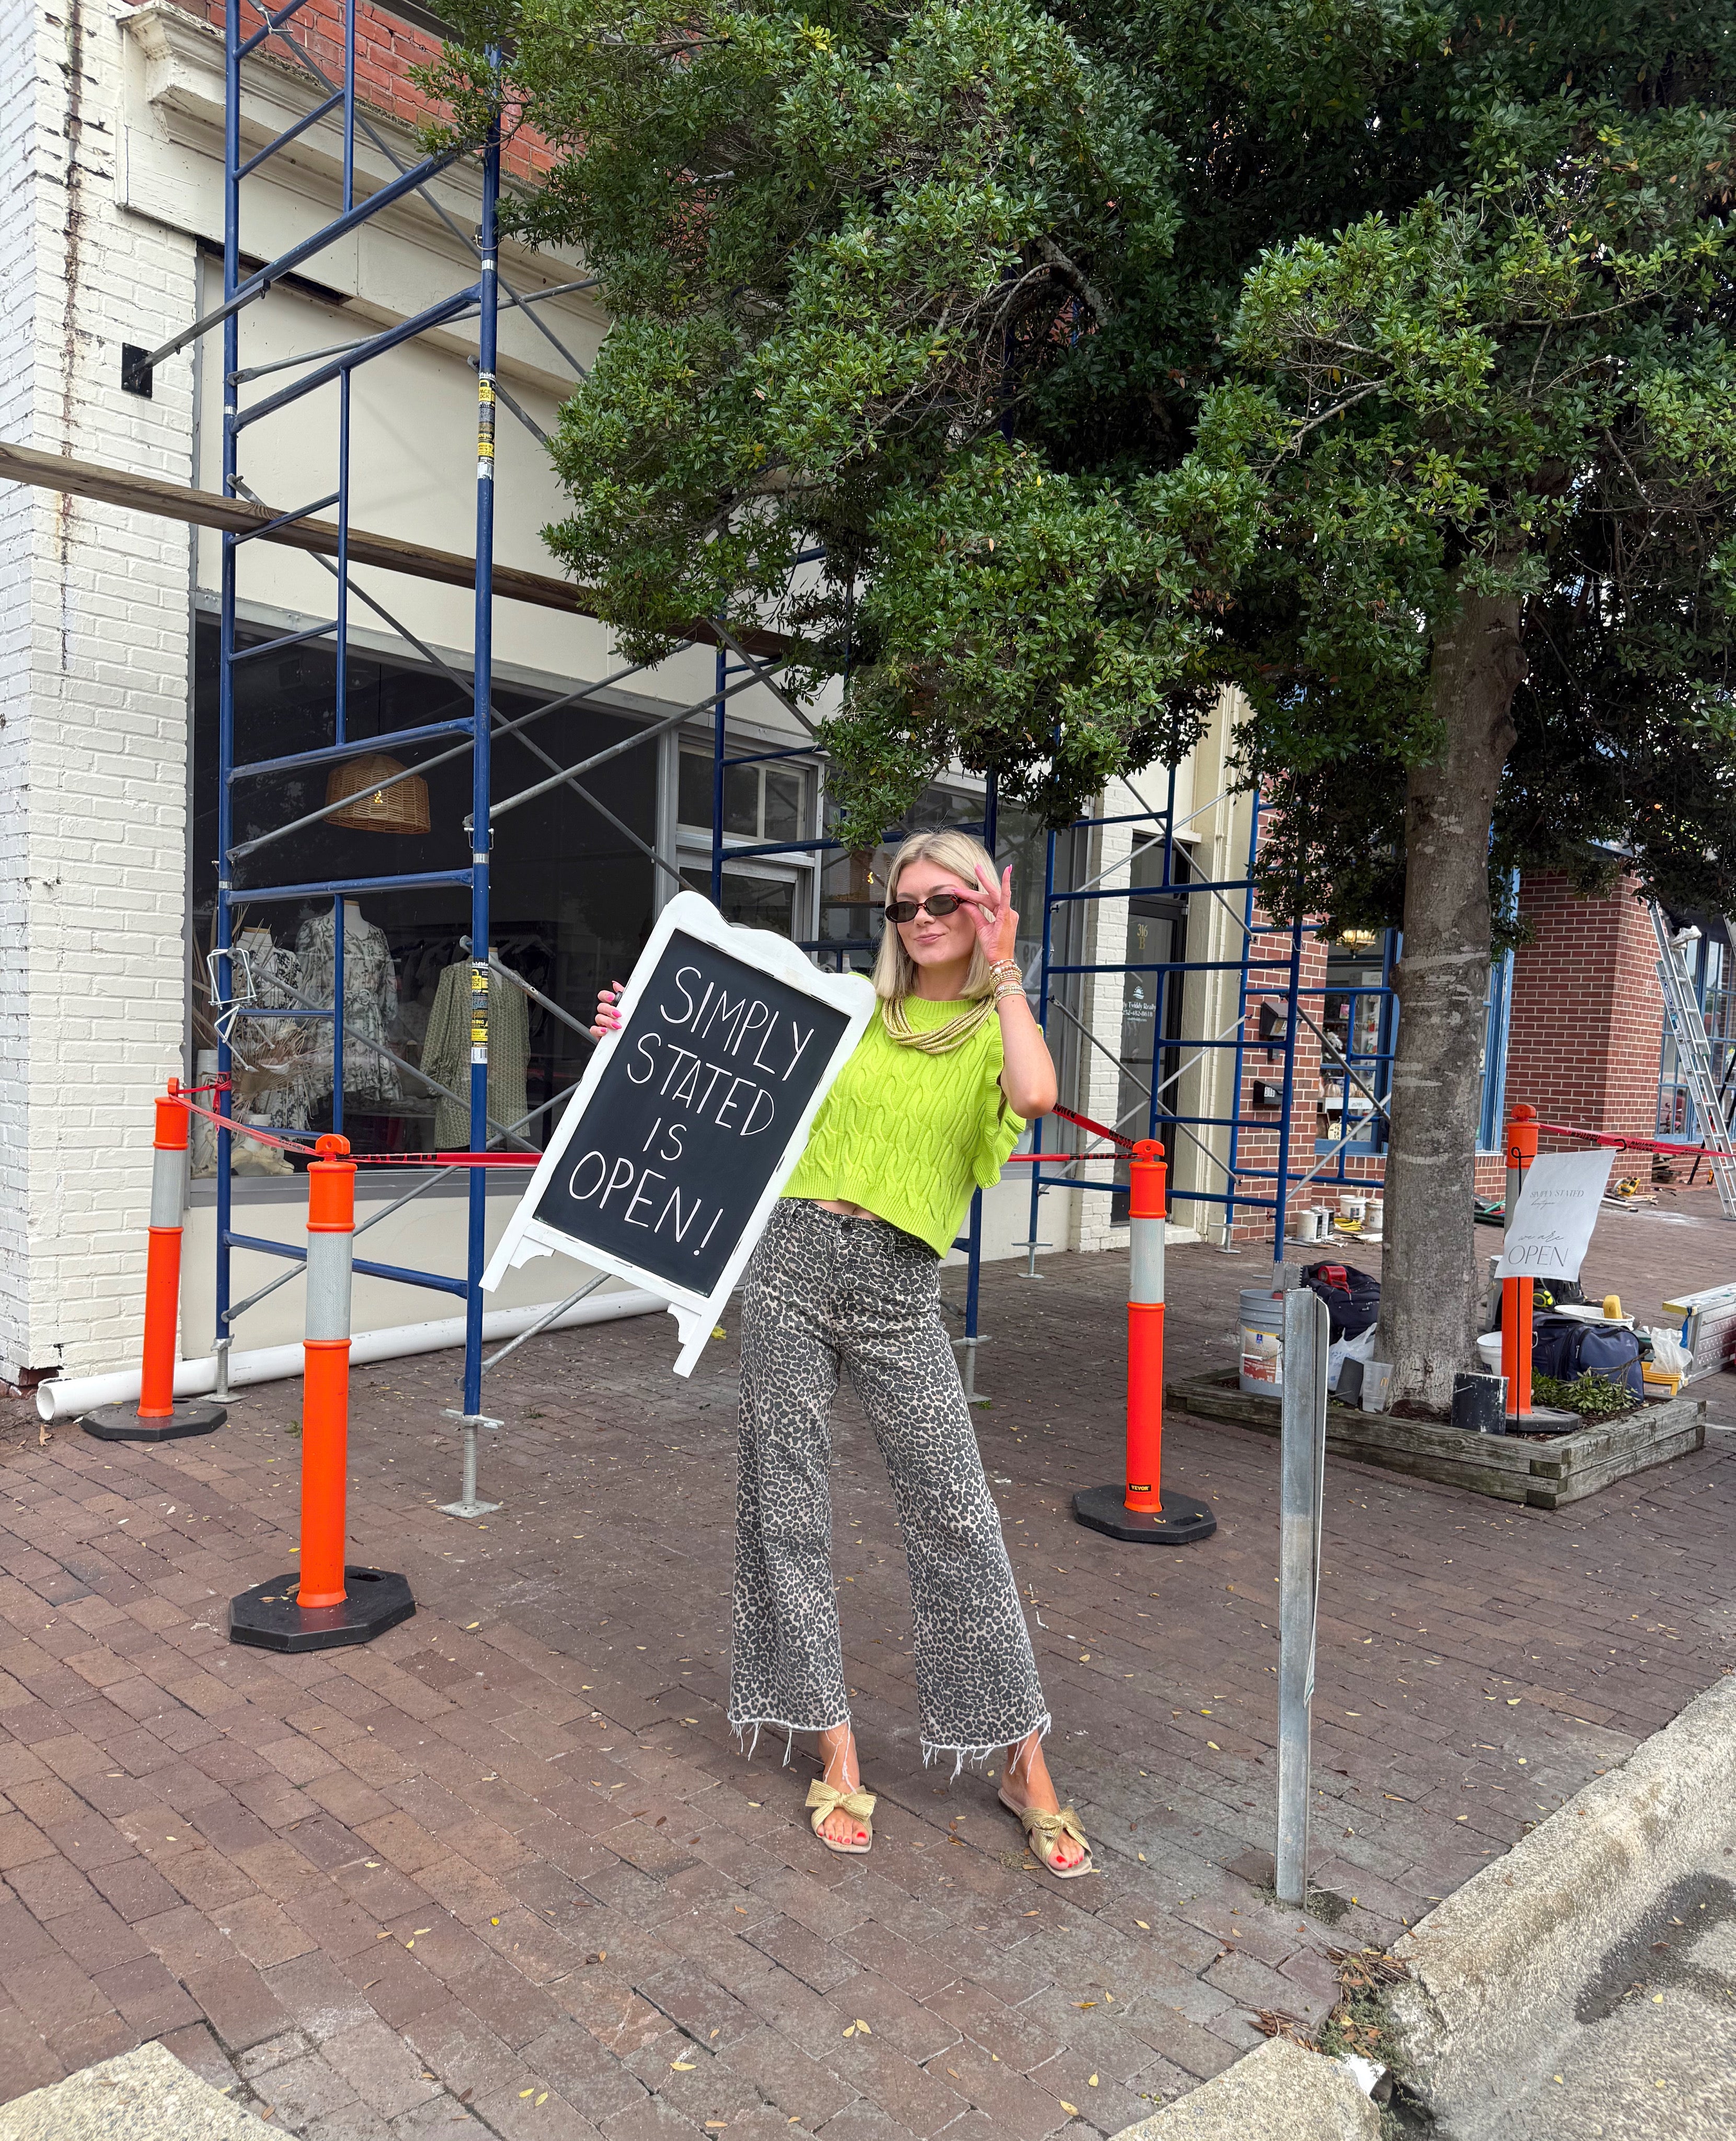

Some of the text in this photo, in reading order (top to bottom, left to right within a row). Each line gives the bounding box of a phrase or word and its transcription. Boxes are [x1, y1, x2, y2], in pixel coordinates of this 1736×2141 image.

[1137, 924, 1148, 937] 316
[1139, 936, 1146, 950] B
[661, 966, 814, 1081] SIMPLY
[627, 1033, 774, 1136] STATED
[643, 1118, 687, 1161] IS
[569, 1151, 723, 1256] OPEN!
[1537, 1230, 1564, 1242] are
[1508, 1245, 1568, 1267] OPEN
